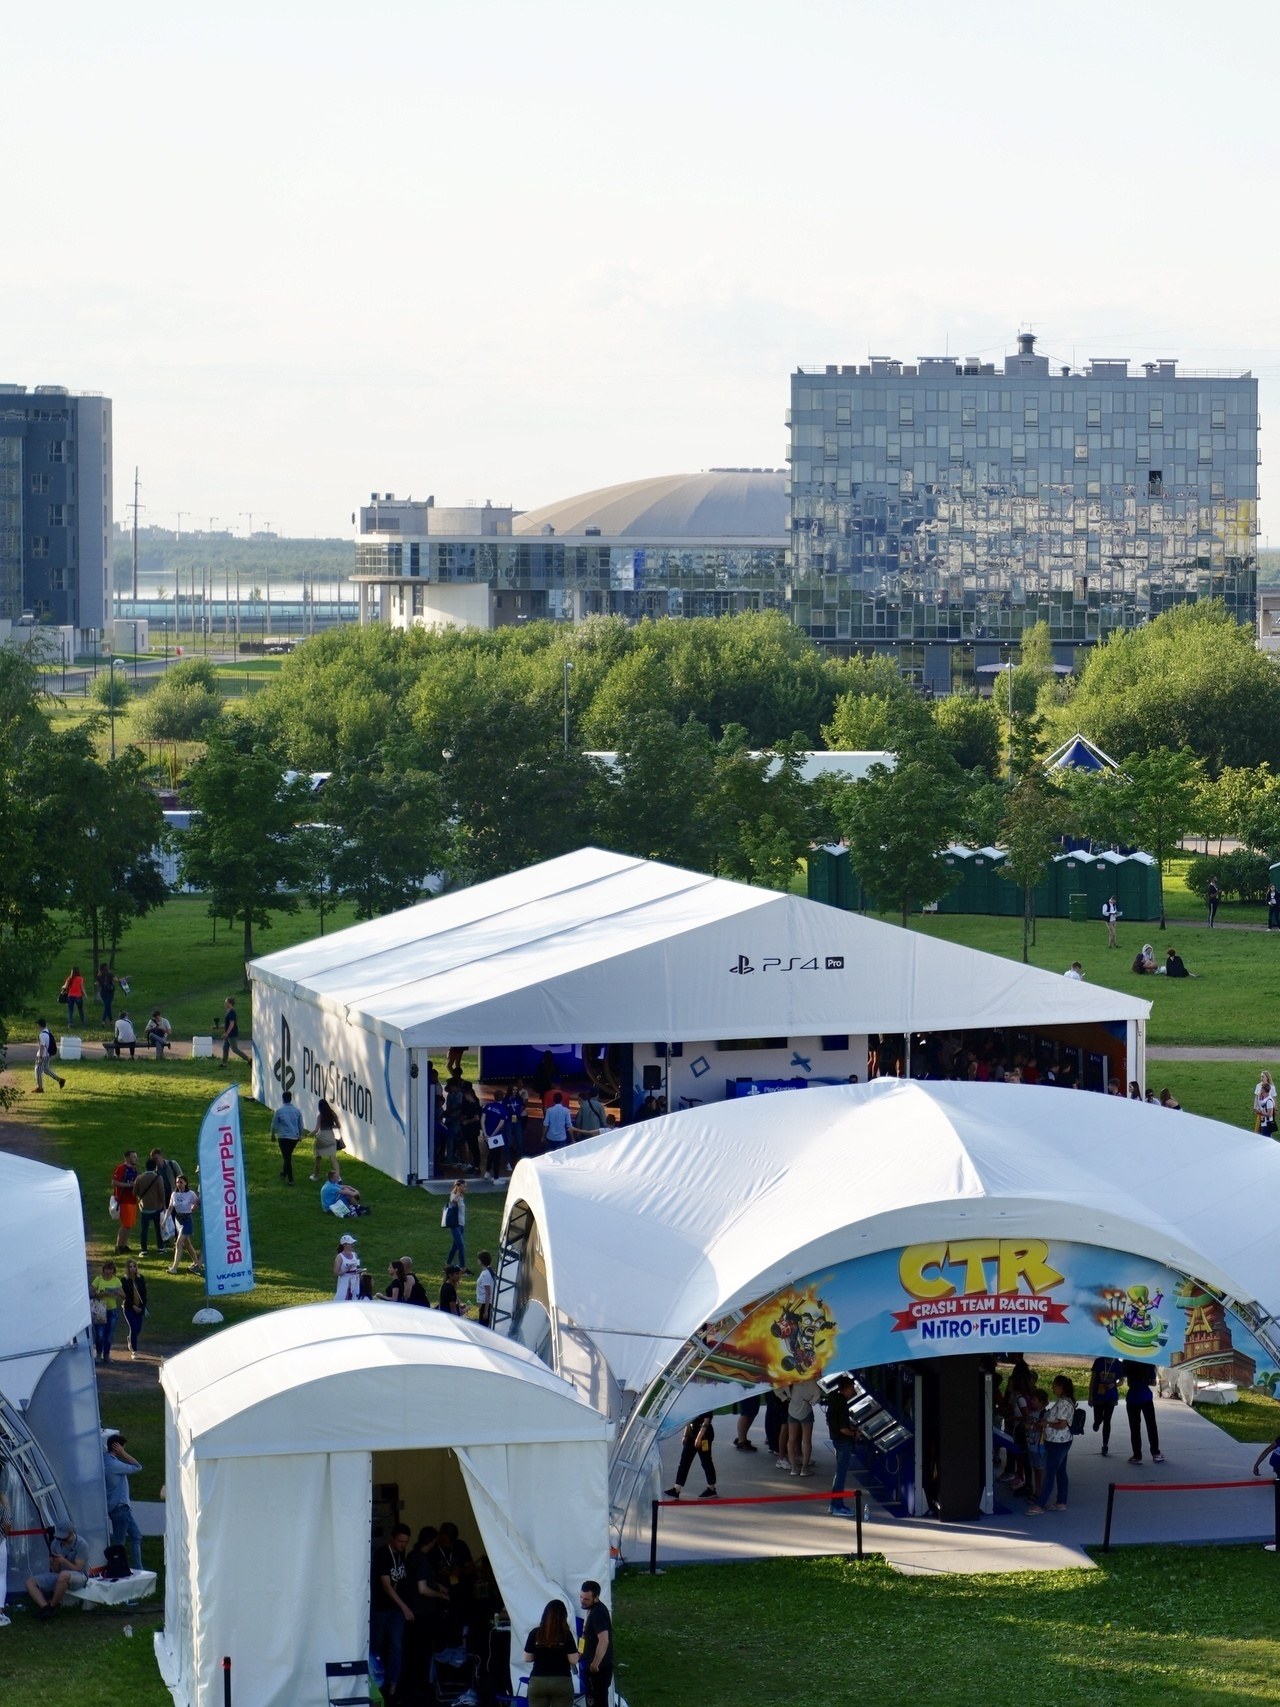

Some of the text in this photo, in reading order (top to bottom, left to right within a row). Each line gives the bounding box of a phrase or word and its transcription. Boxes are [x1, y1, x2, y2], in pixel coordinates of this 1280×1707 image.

[762, 957, 820, 972] PS4
[303, 1046, 373, 1125] PlayStation
[218, 1126, 242, 1264] ВИДЕОИГРЫ
[899, 1238, 1065, 1300] CTR
[911, 1297, 1048, 1318] CRASH TEAM RACING
